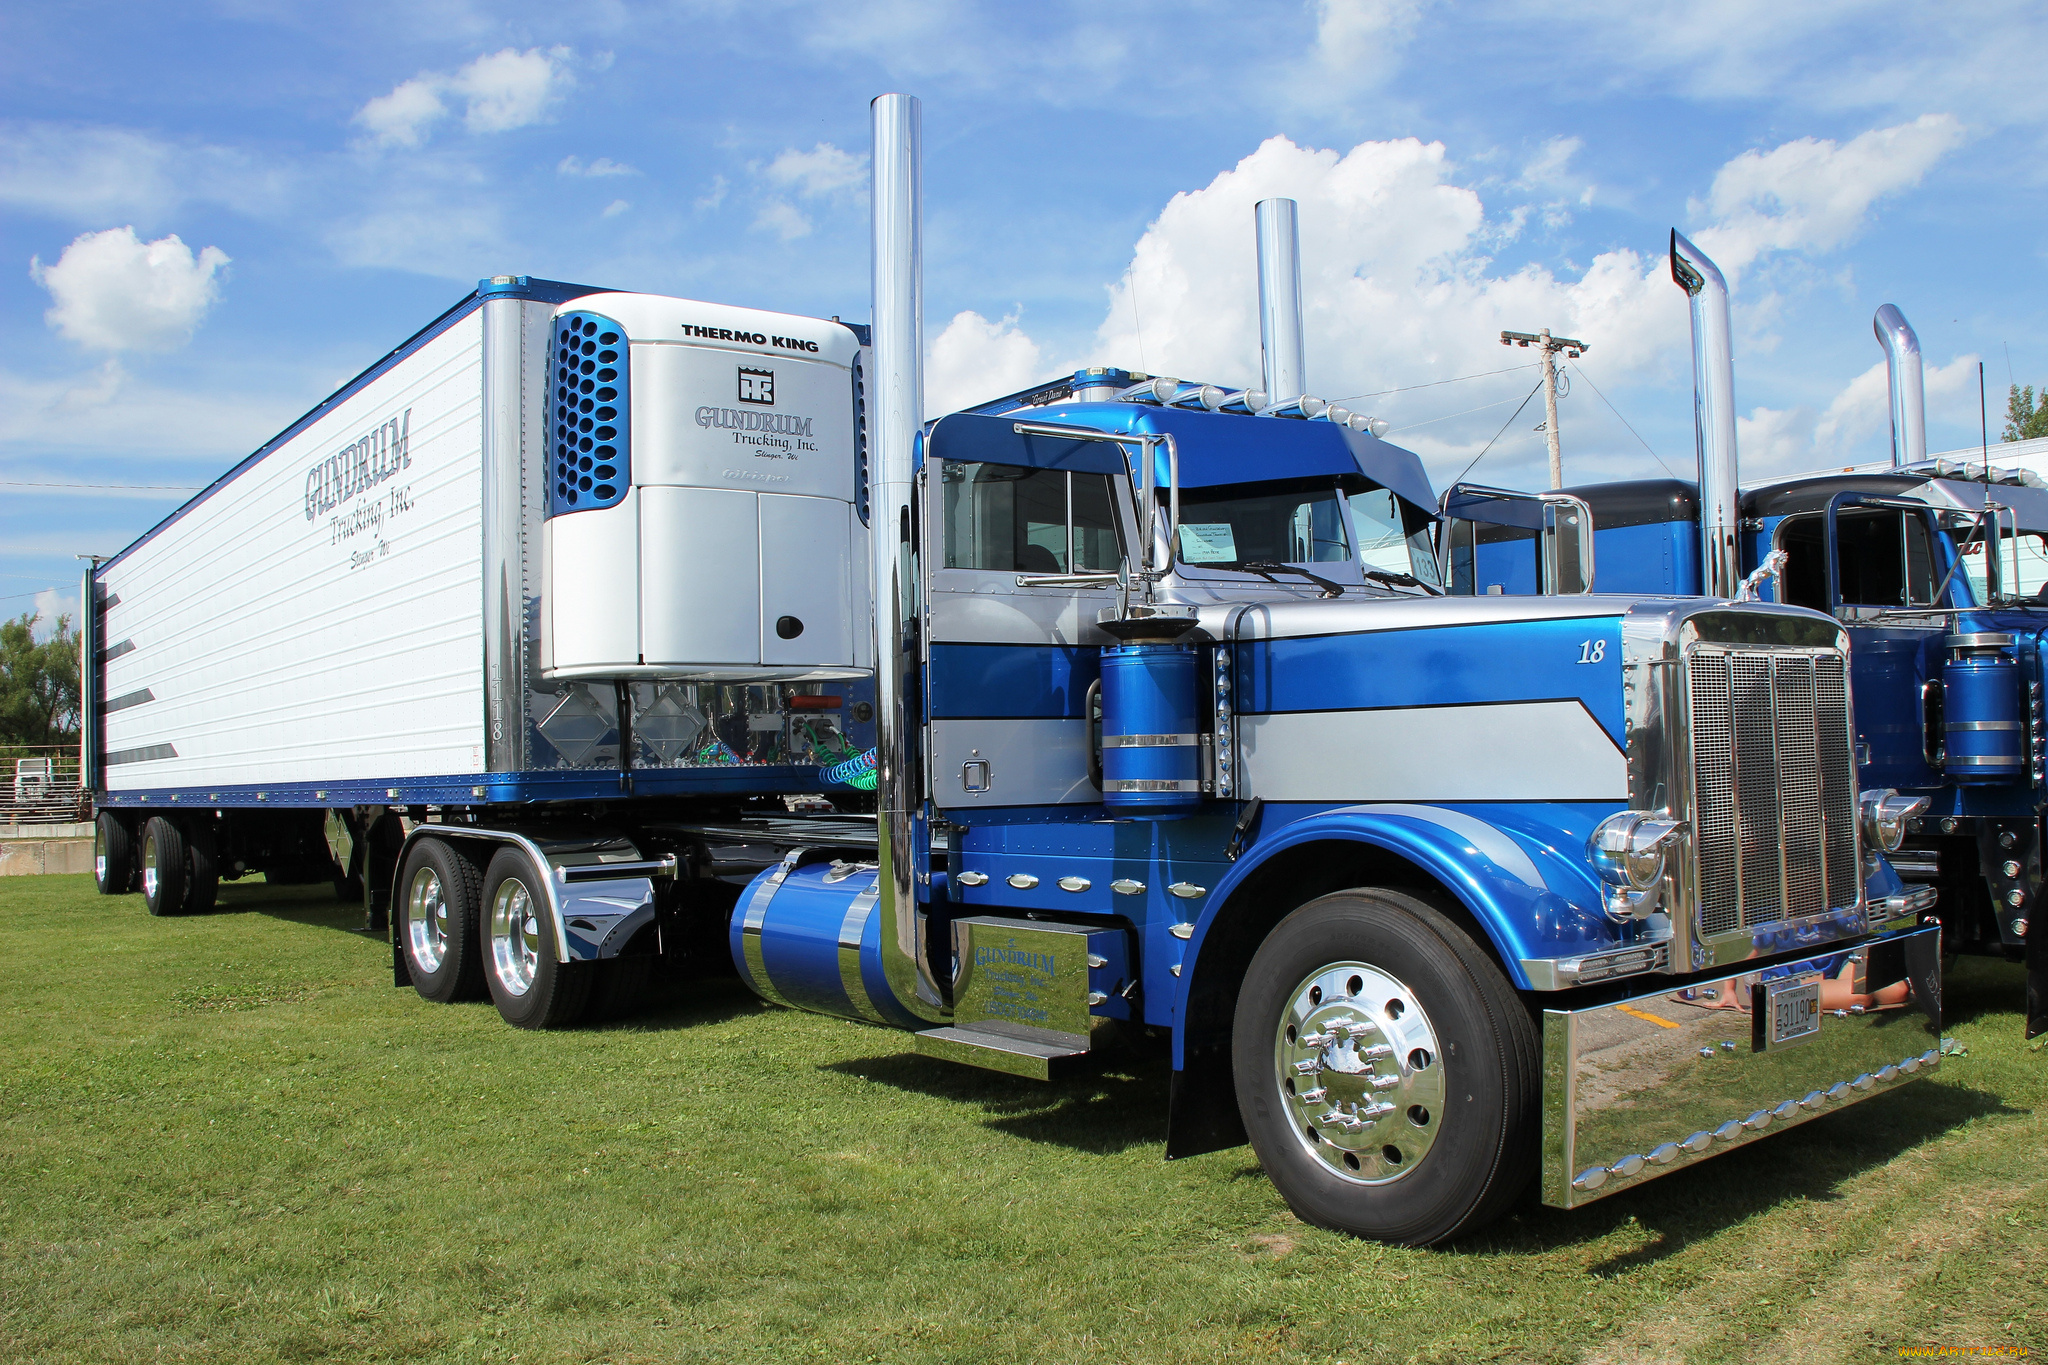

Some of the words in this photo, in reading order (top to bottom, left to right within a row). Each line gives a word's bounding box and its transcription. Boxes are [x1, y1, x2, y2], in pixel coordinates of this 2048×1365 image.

[681, 324, 767, 345] THERMO
[772, 335, 819, 352] KING
[694, 406, 813, 437] GUNDRUM
[732, 432, 792, 452] Trucking,
[797, 438, 819, 451] Inc.
[304, 408, 412, 528] GUNDRUM
[330, 498, 385, 546] Trucking,
[389, 485, 414, 518] Inc.
[1416, 557, 1436, 579] 133
[1576, 639, 1607, 664] 18
[491, 663, 504, 741] 1118
[975, 946, 1056, 977] GUNDRUM
[1783, 998, 1810, 1028] 31190
